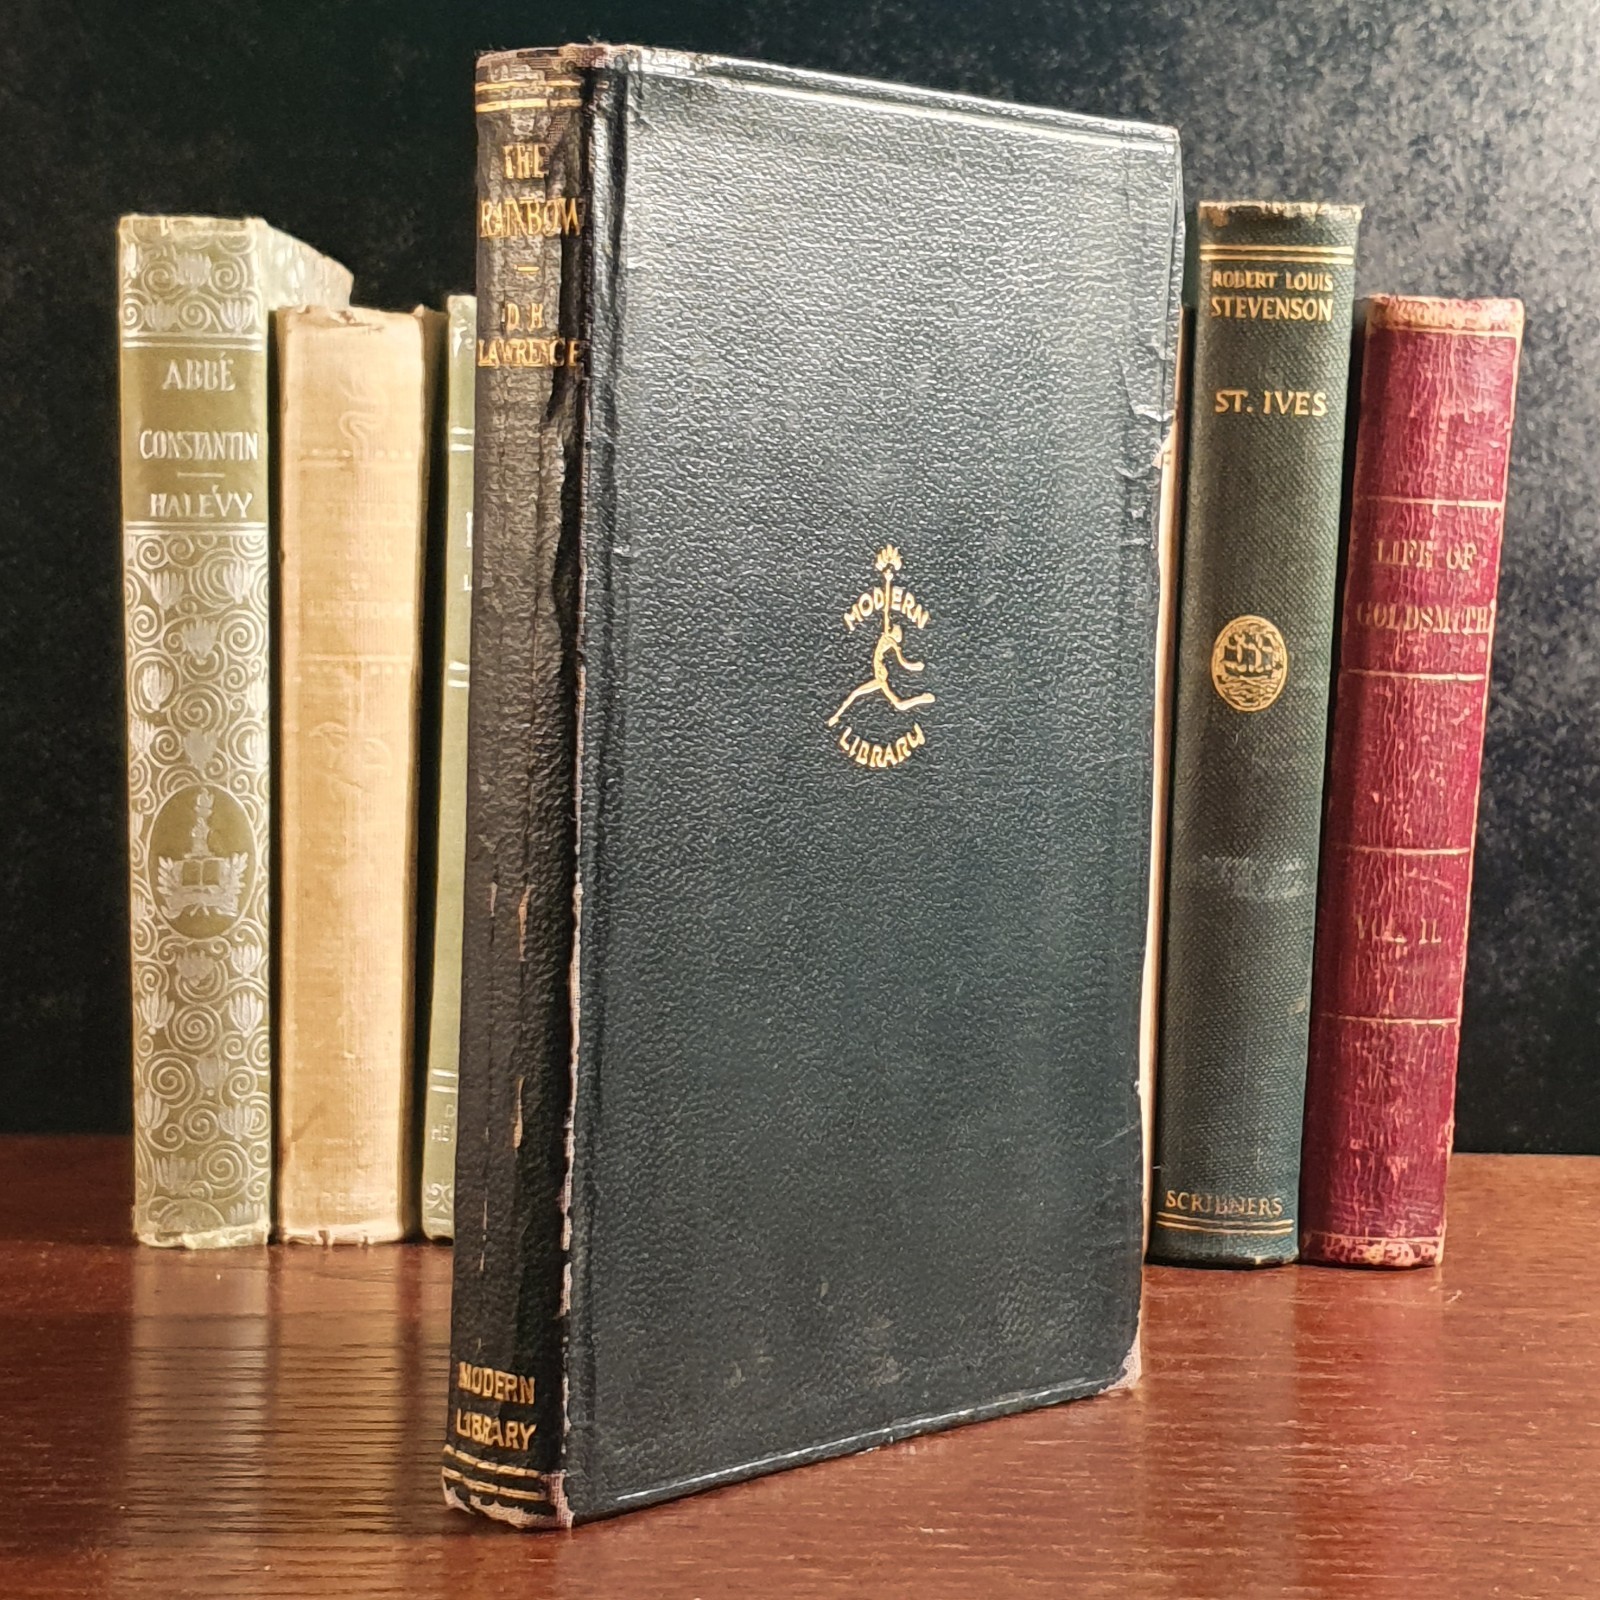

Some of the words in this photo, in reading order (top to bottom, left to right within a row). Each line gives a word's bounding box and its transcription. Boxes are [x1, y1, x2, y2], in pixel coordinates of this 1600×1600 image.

[503, 143, 549, 179] THE
[480, 196, 581, 238] RAINBOW
[1211, 270, 1276, 289] ROBERT
[1285, 271, 1334, 292] LOUIS
[1211, 296, 1334, 322] STEVENSON
[477, 335, 581, 368] LAWRENCE
[162, 351, 236, 391] ABBÉ
[1215, 389, 1254, 414] ST.
[1263, 389, 1329, 417] IVES
[139, 430, 259, 461] CONSTANTIN
[150, 484, 253, 519] HALÉVY
[1375, 539, 1434, 571] LIFE
[1446, 542, 1478, 571] OF
[844, 586, 931, 632] MODERN
[1357, 602, 1489, 635] GOLDSMITH
[839, 722, 926, 768] LIBRARY
[1164, 1189, 1283, 1218] SCRIBNERS
[457, 1361, 536, 1405] MODERN
[456, 1408, 537, 1451] LIBRARY
